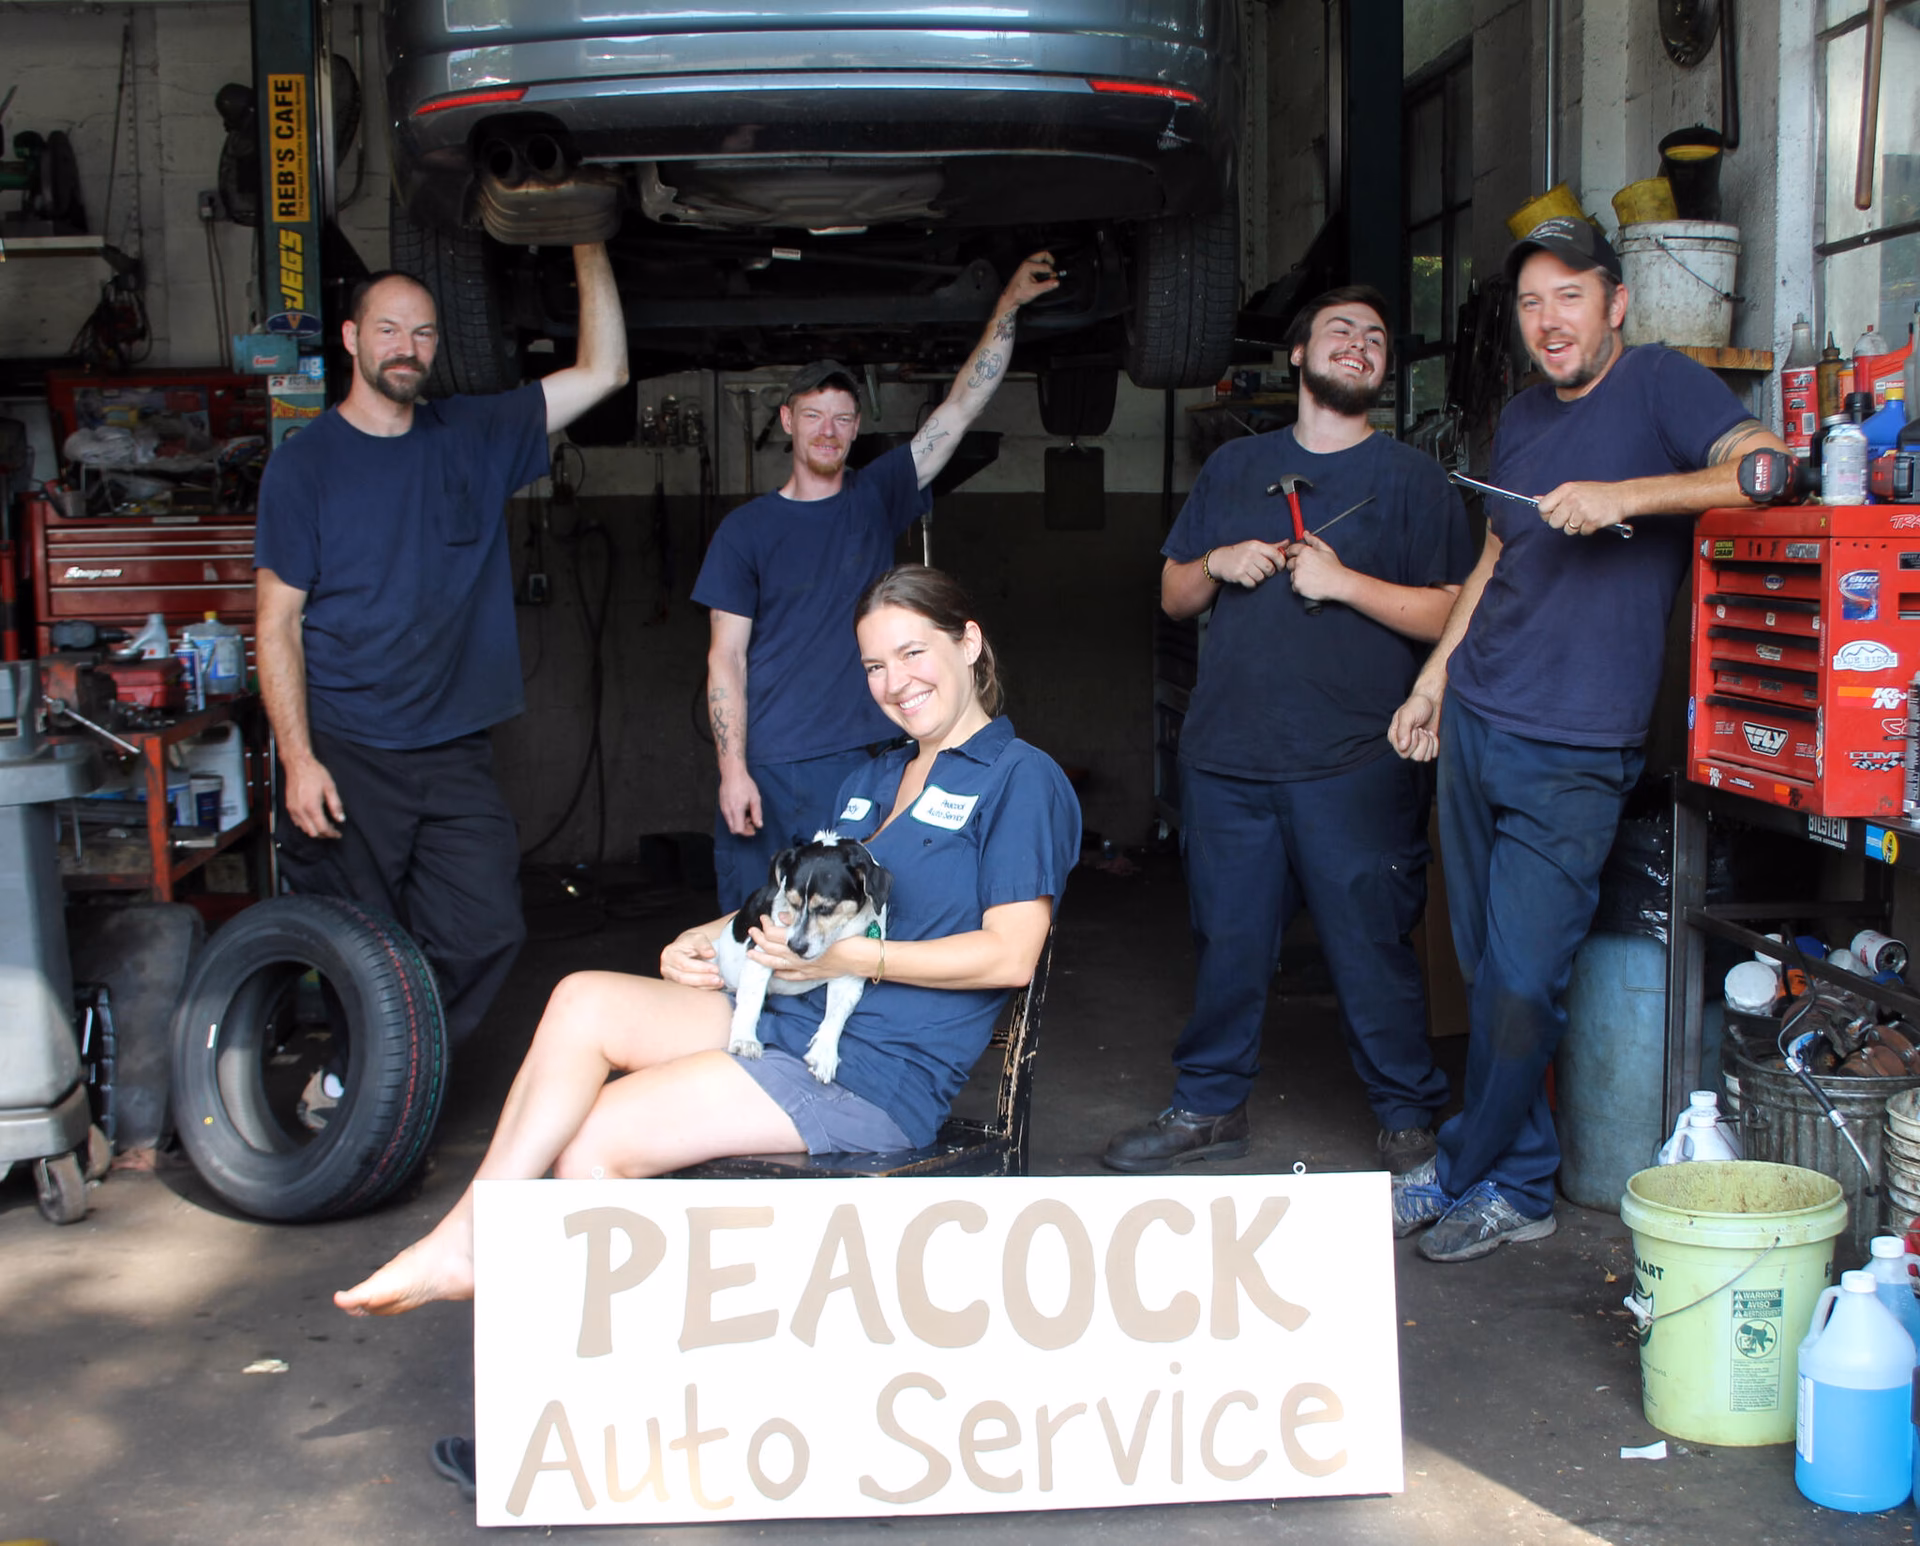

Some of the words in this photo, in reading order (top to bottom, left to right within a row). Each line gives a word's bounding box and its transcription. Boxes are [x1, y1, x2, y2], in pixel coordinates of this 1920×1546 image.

[274, 79, 295, 140] CAFE
[277, 147, 297, 217] REB'S
[1755, 459, 1764, 492] FUEL
[1847, 575, 1879, 583] BUD
[1835, 656, 1860, 665] BLUE
[1864, 655, 1896, 665] RIDGE
[1808, 813, 1848, 842] BILSTEIN
[563, 1195, 1311, 1358] PEACOCK
[1742, 1290, 1780, 1299] WARNING
[1746, 1300, 1770, 1308] AVISO
[506, 1382, 810, 1516] Auto
[859, 1361, 1348, 1504] Service
